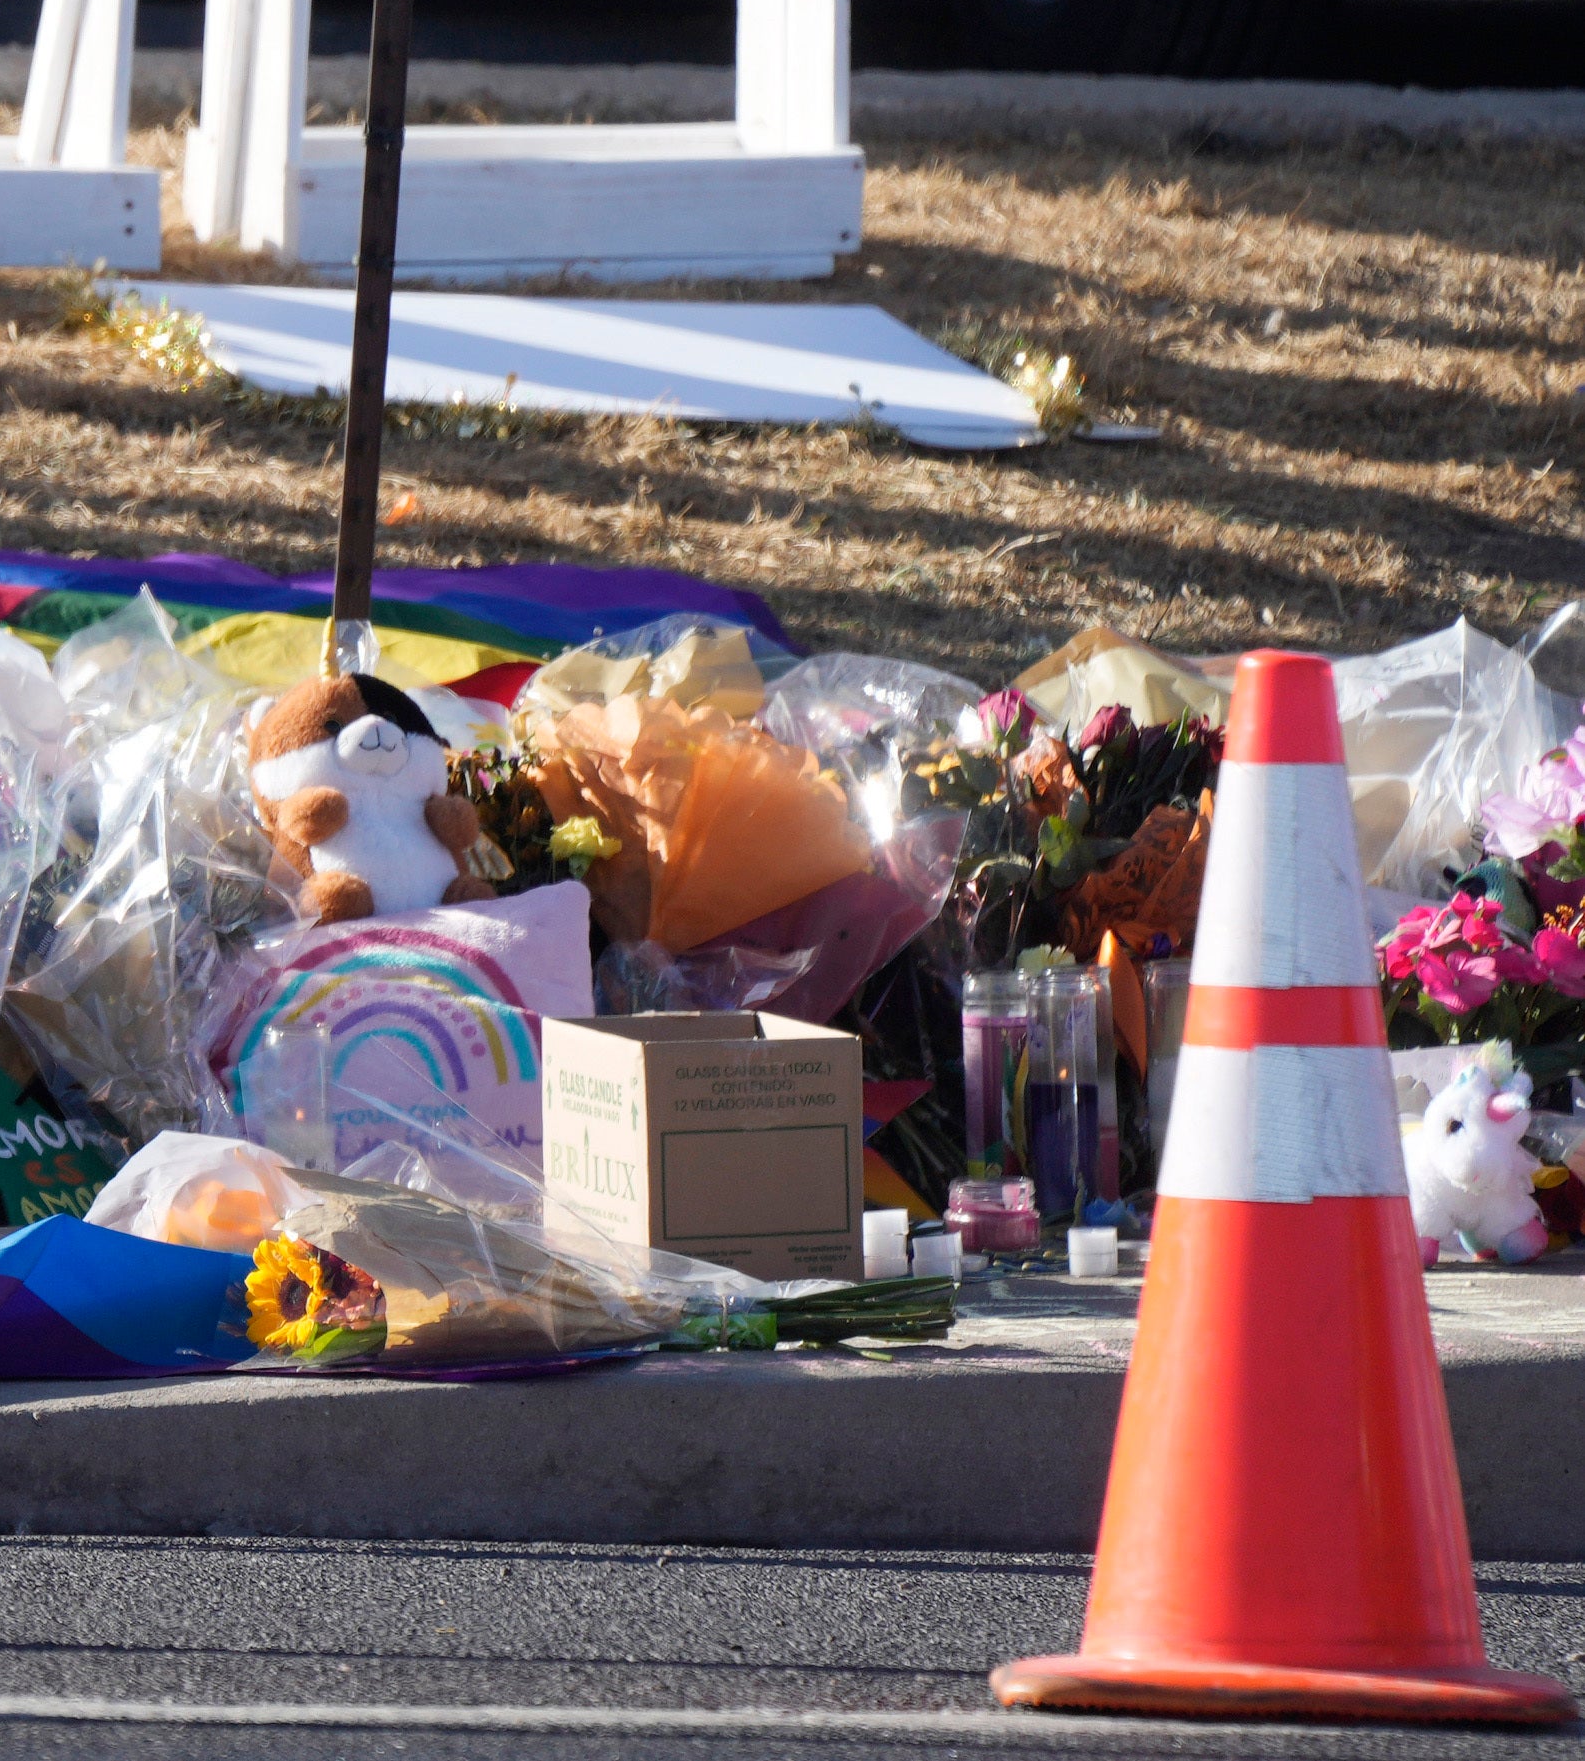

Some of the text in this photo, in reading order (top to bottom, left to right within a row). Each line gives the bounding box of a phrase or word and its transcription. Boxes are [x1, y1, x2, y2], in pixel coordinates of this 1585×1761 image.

[559, 1070, 622, 1106] GLASS CANDLE
[675, 1066, 720, 1080] GLASS
[799, 1093, 837, 1107] VASO
[550, 1141, 637, 1202] BRILUX
[20, 1182, 106, 1225] AMO
